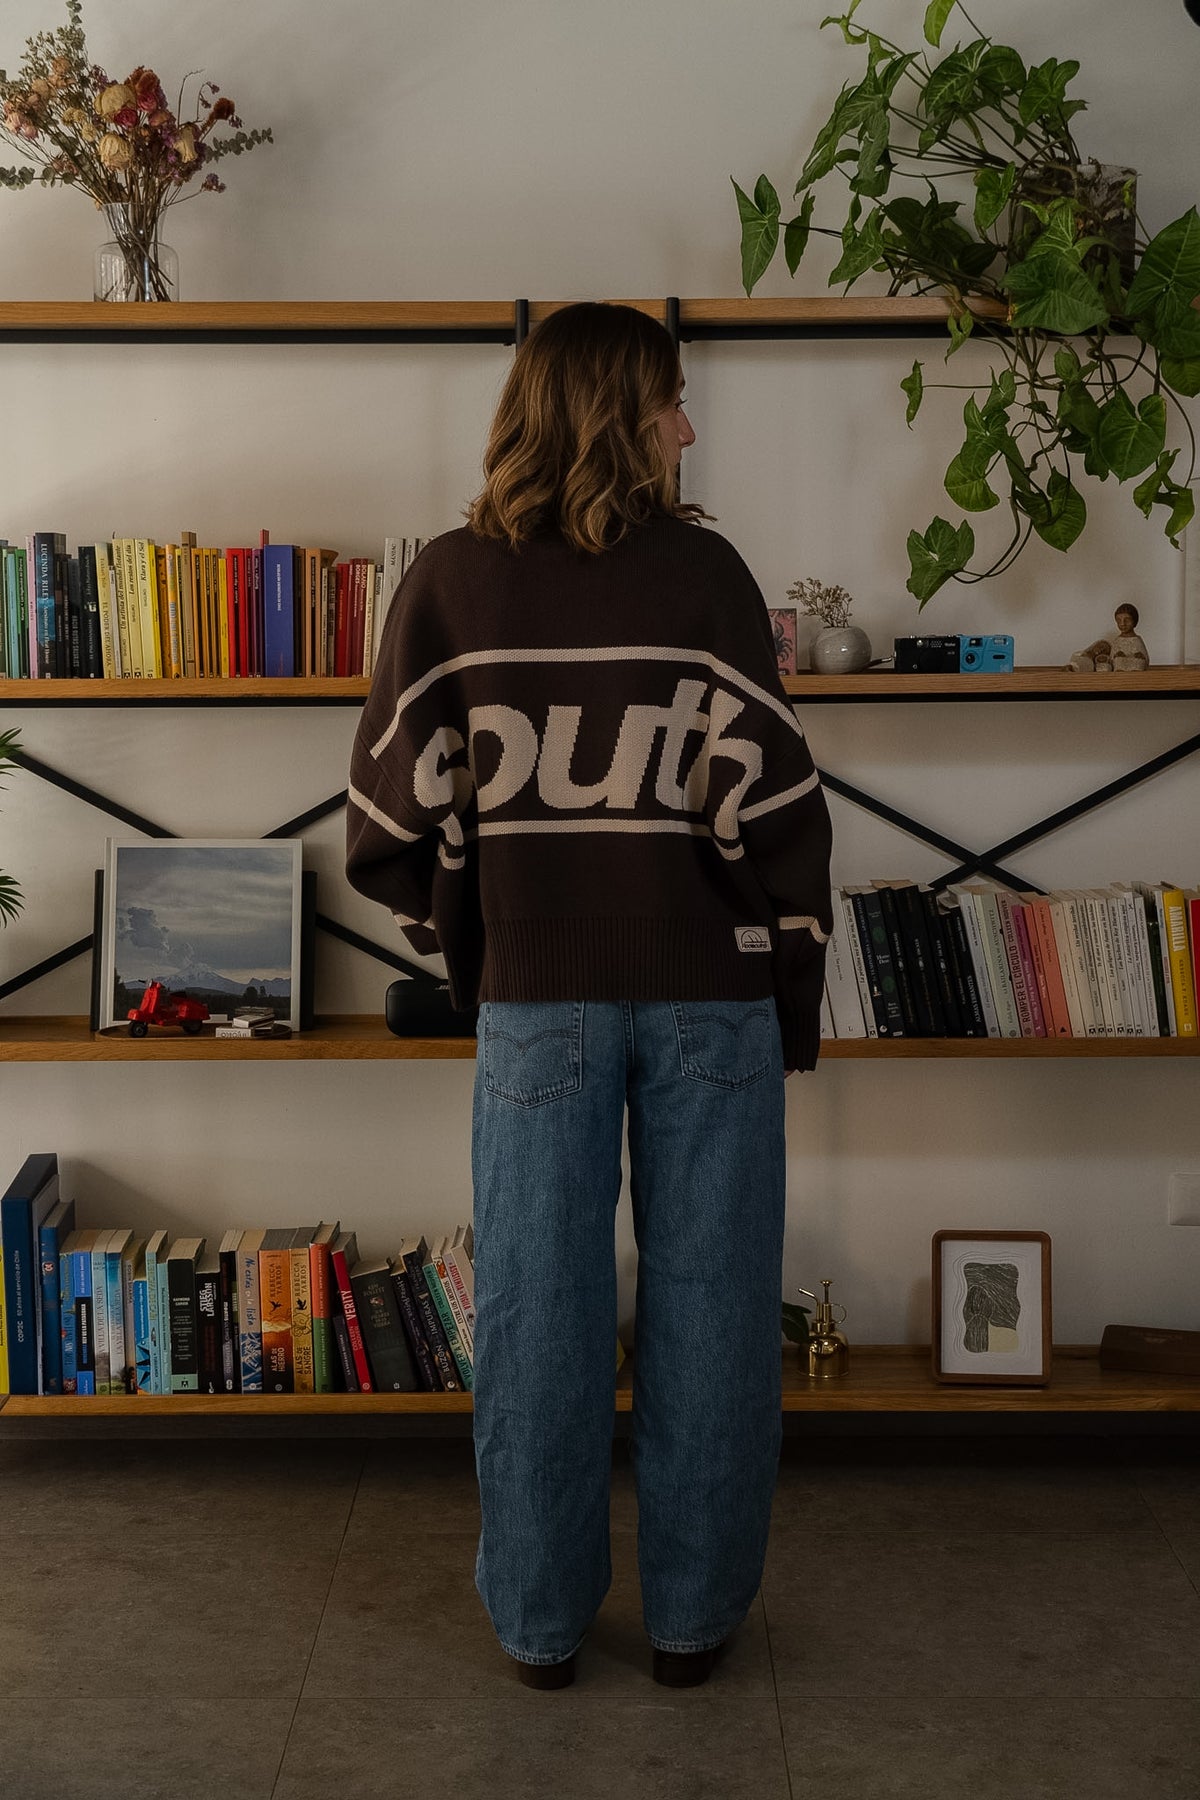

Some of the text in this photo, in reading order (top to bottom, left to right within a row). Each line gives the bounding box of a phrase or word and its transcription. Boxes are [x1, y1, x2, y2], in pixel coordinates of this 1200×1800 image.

[40, 543, 50, 603] LUCINDA RILEY
[1001, 899, 1014, 942] COLLEEN HOOVER
[1168, 905, 1186, 952] AMARILLA
[1106, 950, 1114, 969] peligros
[1008, 944, 1031, 1022] ROMPER EL CÍRCULO
[245, 1258, 255, 1268] No
[244, 1269, 255, 1288] estás
[199, 1289, 207, 1312] STIEG
[205, 1282, 215, 1317] LARSSON
[341, 1290, 356, 1320] VERITY
[246, 1308, 258, 1326] lista
[421, 1301, 437, 1335] IMPURAS
[441, 1312, 459, 1345] EMPEZAR
[349, 1326, 358, 1351] COLLEEN
[354, 1325, 362, 1350] HOOVER
[271, 1355, 279, 1372] ALAS
[295, 1355, 303, 1375] ALAS
[303, 1346, 312, 1375] SANGRE
[457, 1352, 471, 1380] VOLVER
